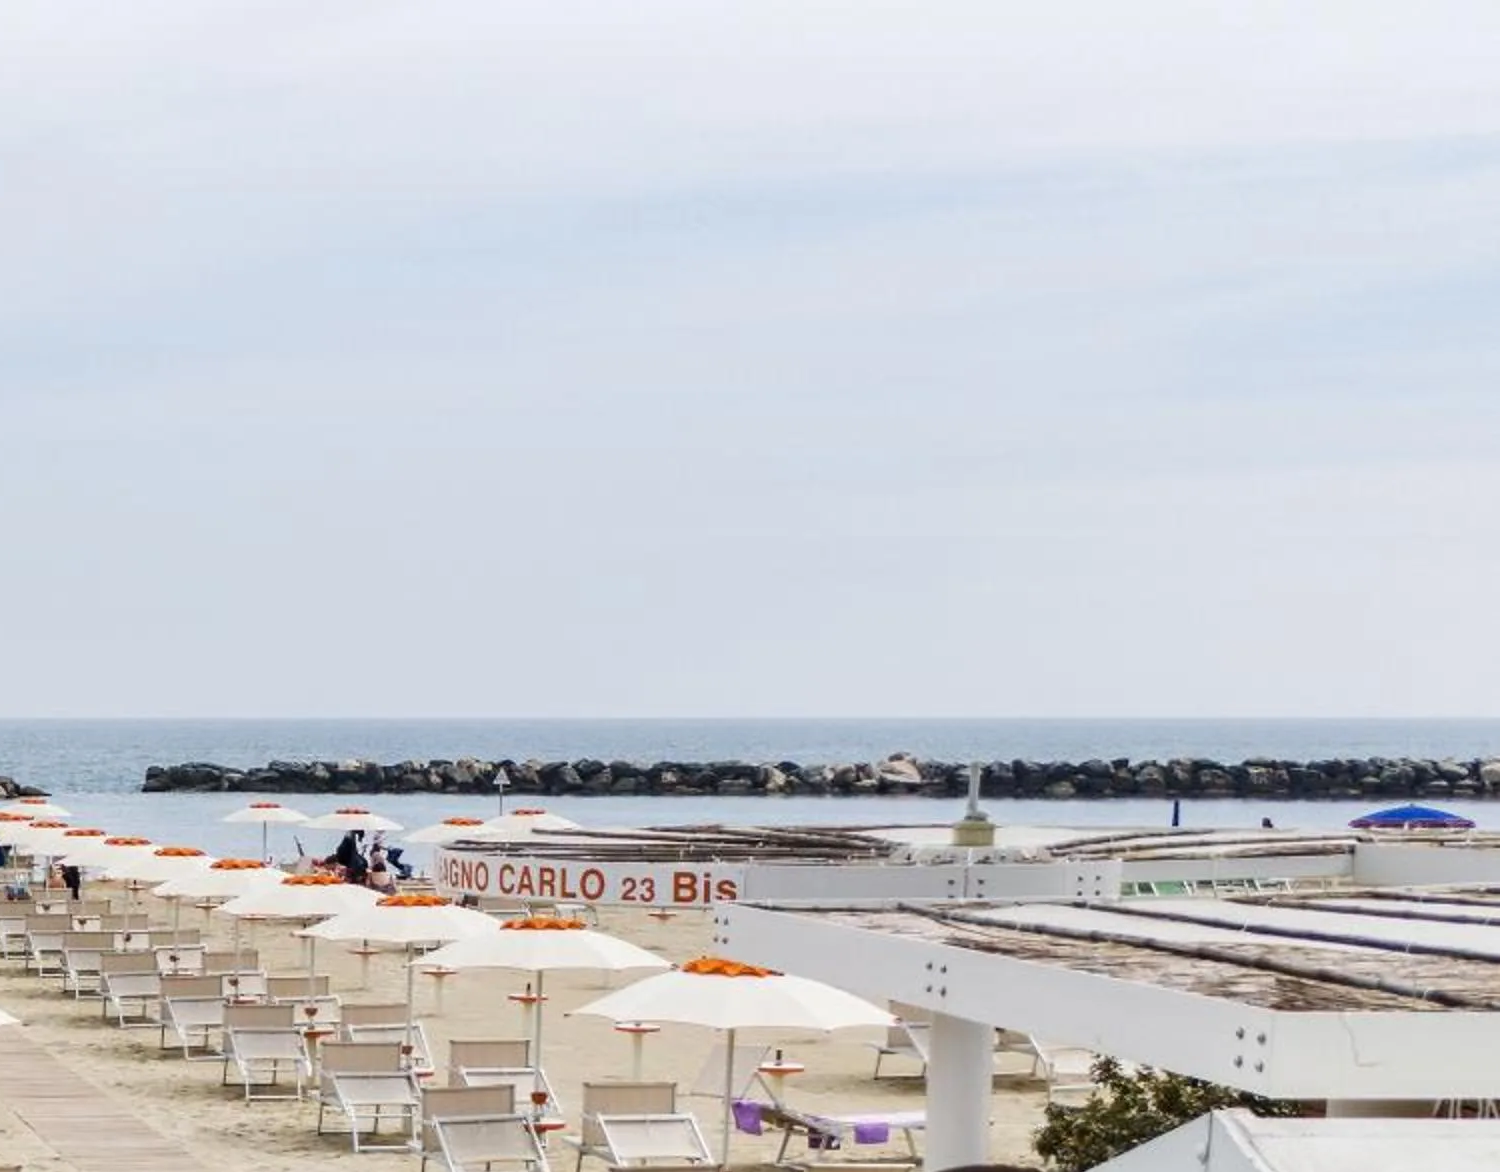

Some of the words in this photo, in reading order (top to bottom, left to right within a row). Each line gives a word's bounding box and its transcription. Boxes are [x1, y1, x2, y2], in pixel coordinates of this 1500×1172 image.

[498, 863, 606, 900] CARLO
[621, 877, 656, 901] 23
[672, 871, 738, 903] Bis
